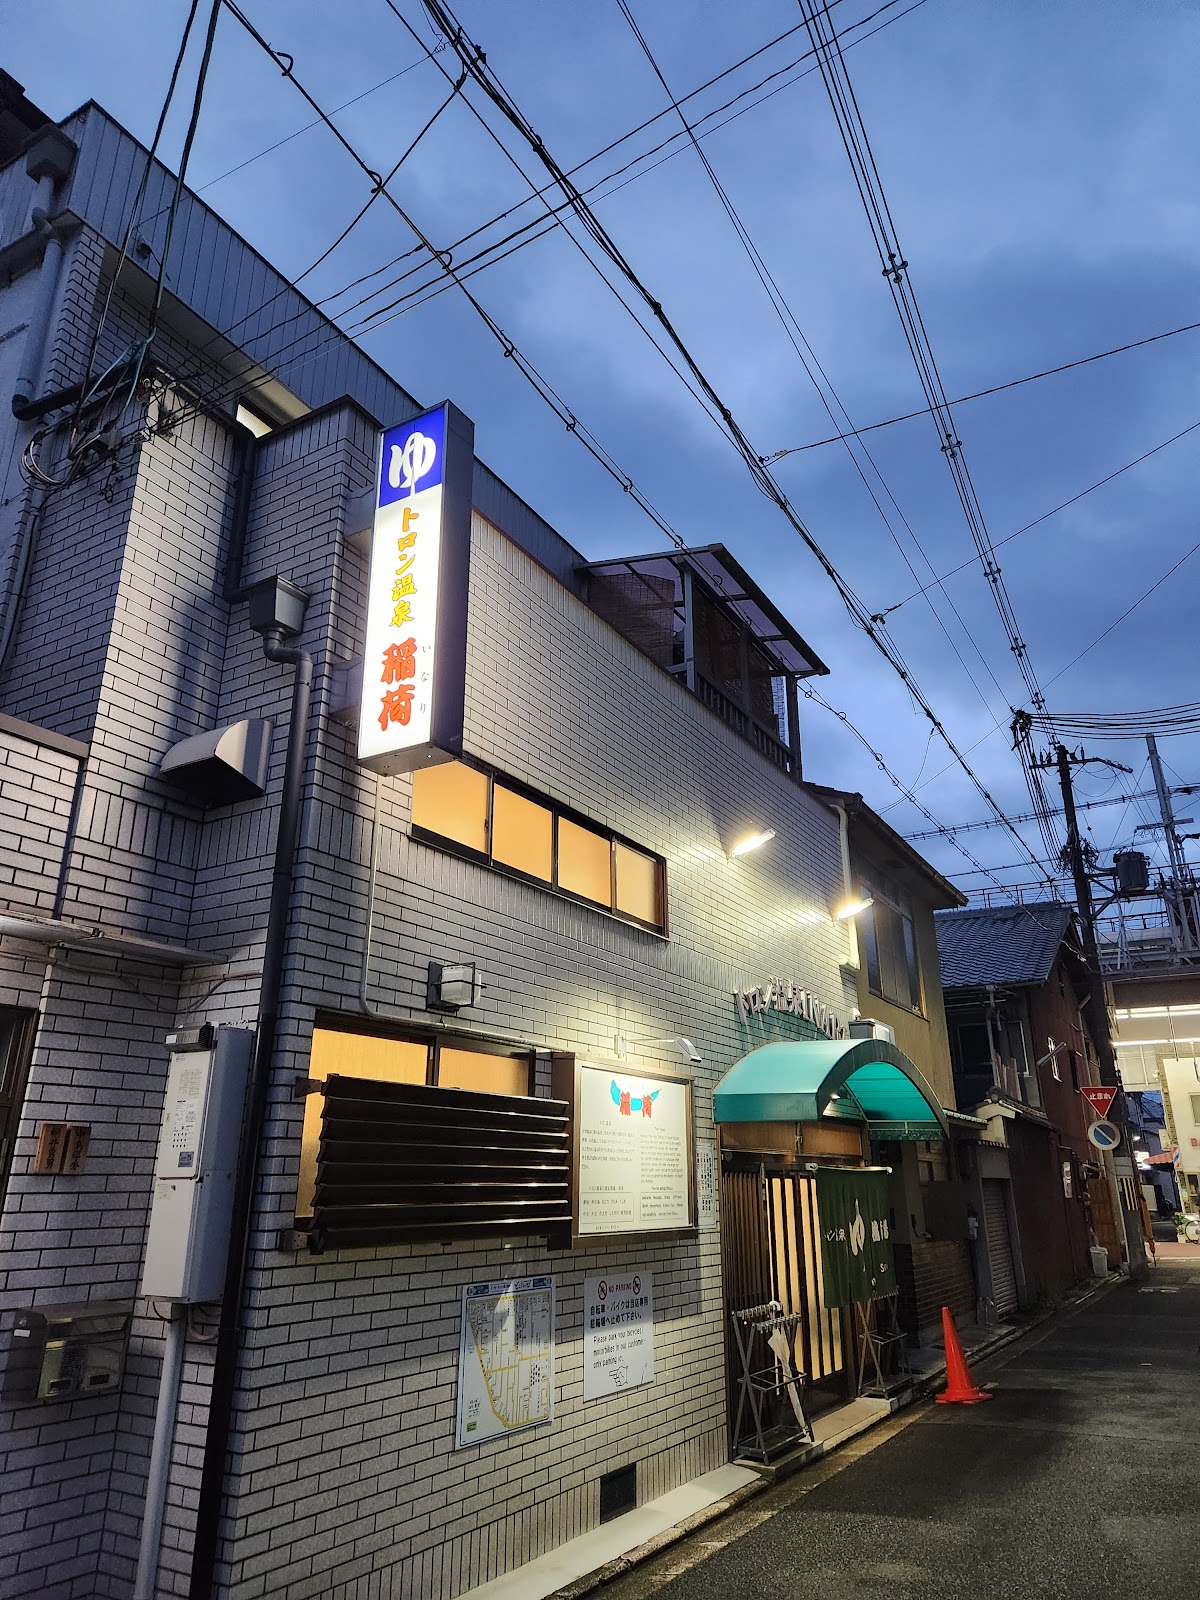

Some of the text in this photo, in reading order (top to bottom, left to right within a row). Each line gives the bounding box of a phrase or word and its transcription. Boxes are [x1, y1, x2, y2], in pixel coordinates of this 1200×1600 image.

[388, 431, 436, 496] ゆ
[377, 506, 420, 732] トロン温泉 稲荷
[419, 645, 432, 714] いなり
[1089, 1092, 1111, 1100] 止まれ
[608, 1282, 632, 1293] NO PARKING
[593, 1335, 607, 1345] Please
[608, 1333, 618, 1342] park
[593, 1359, 602, 1369] only
[602, 1355, 617, 1367] parking
